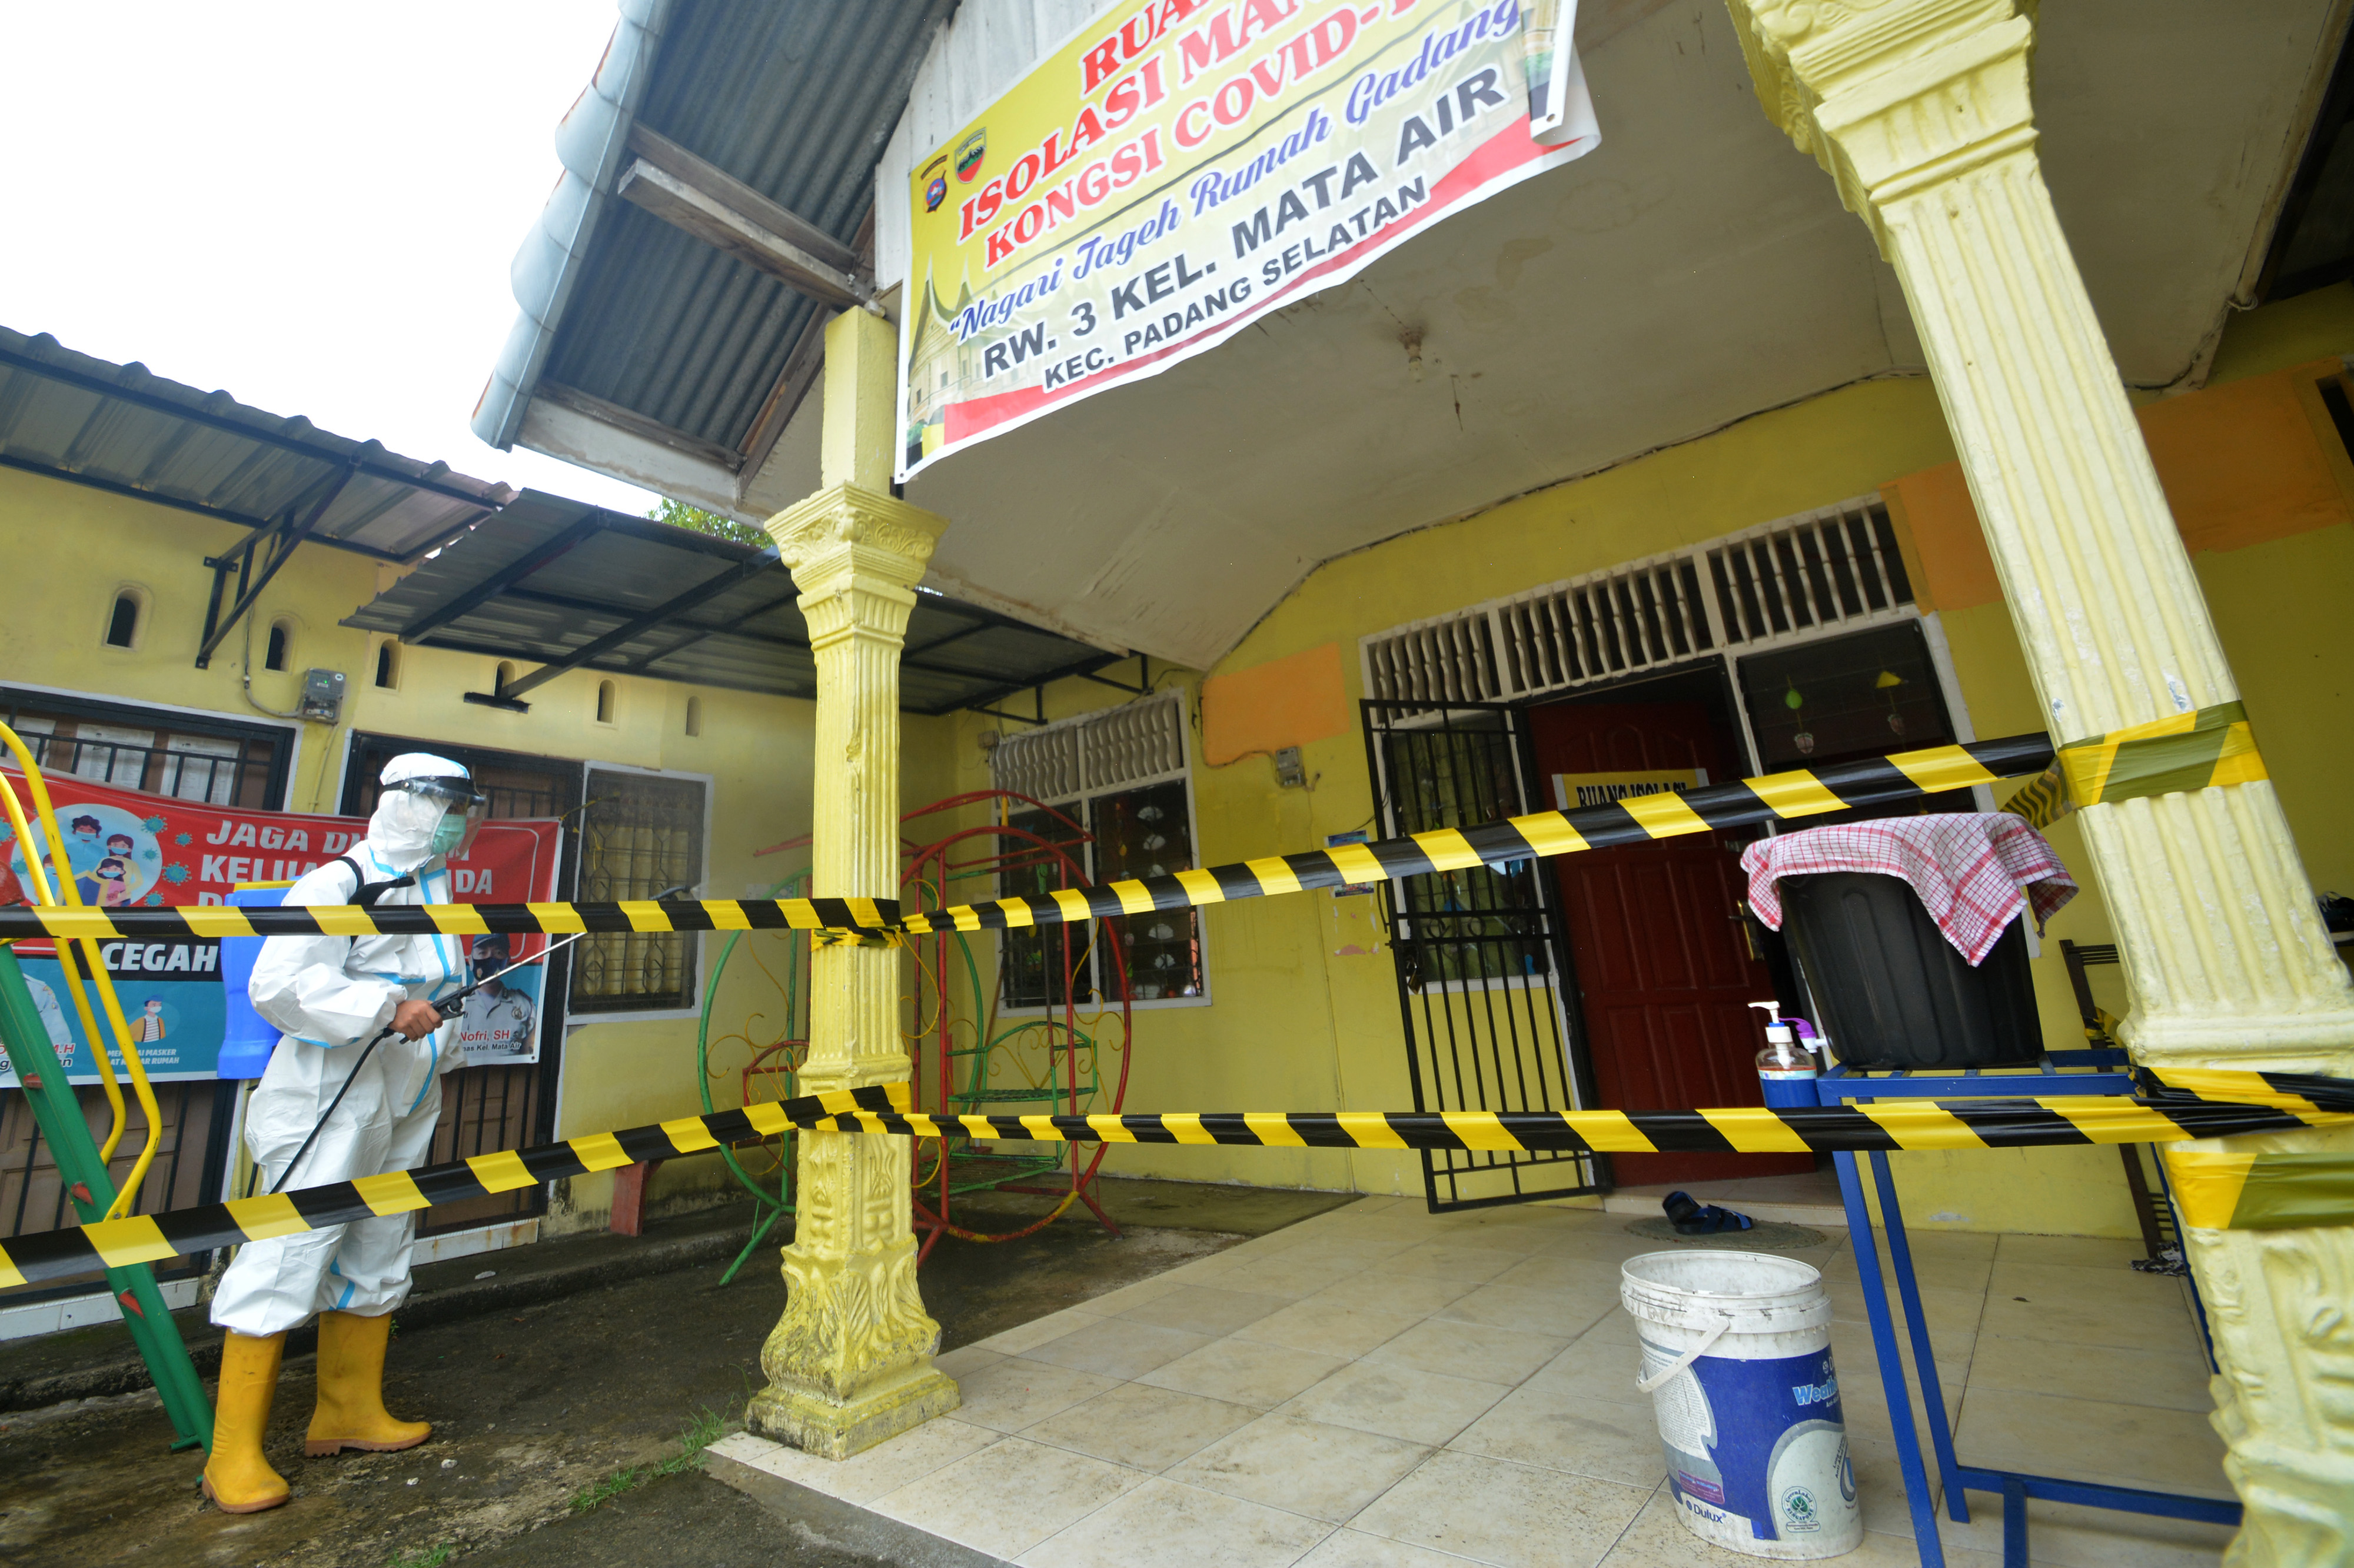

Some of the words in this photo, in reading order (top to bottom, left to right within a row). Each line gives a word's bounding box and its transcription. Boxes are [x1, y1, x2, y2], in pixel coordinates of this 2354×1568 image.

[1083, 0, 1210, 95] RUA
[960, 56, 1165, 241] ISOLASI
[1073, 198, 1181, 279] Tageh
[1191, 107, 1332, 217] Rumah
[1346, 0, 1520, 126] Gadang
[984, 321, 1057, 378] RW.
[1070, 302, 1097, 337] 3
[1111, 254, 1216, 320] KEL.
[1232, 152, 1379, 259] MATA
[1397, 68, 1505, 167] AIR
[987, 128, 1162, 268] KONGSI
[1045, 348, 1115, 389] KEC.
[1124, 277, 1252, 355] PADANG
[1262, 175, 1426, 287] SELATAN
[206, 820, 308, 851] JAGA
[101, 942, 219, 972] CEGAH
[493, 1030, 510, 1040] SH
[510, 1042, 522, 1050] Air
[1694, 1503, 1723, 1524] Dulux
